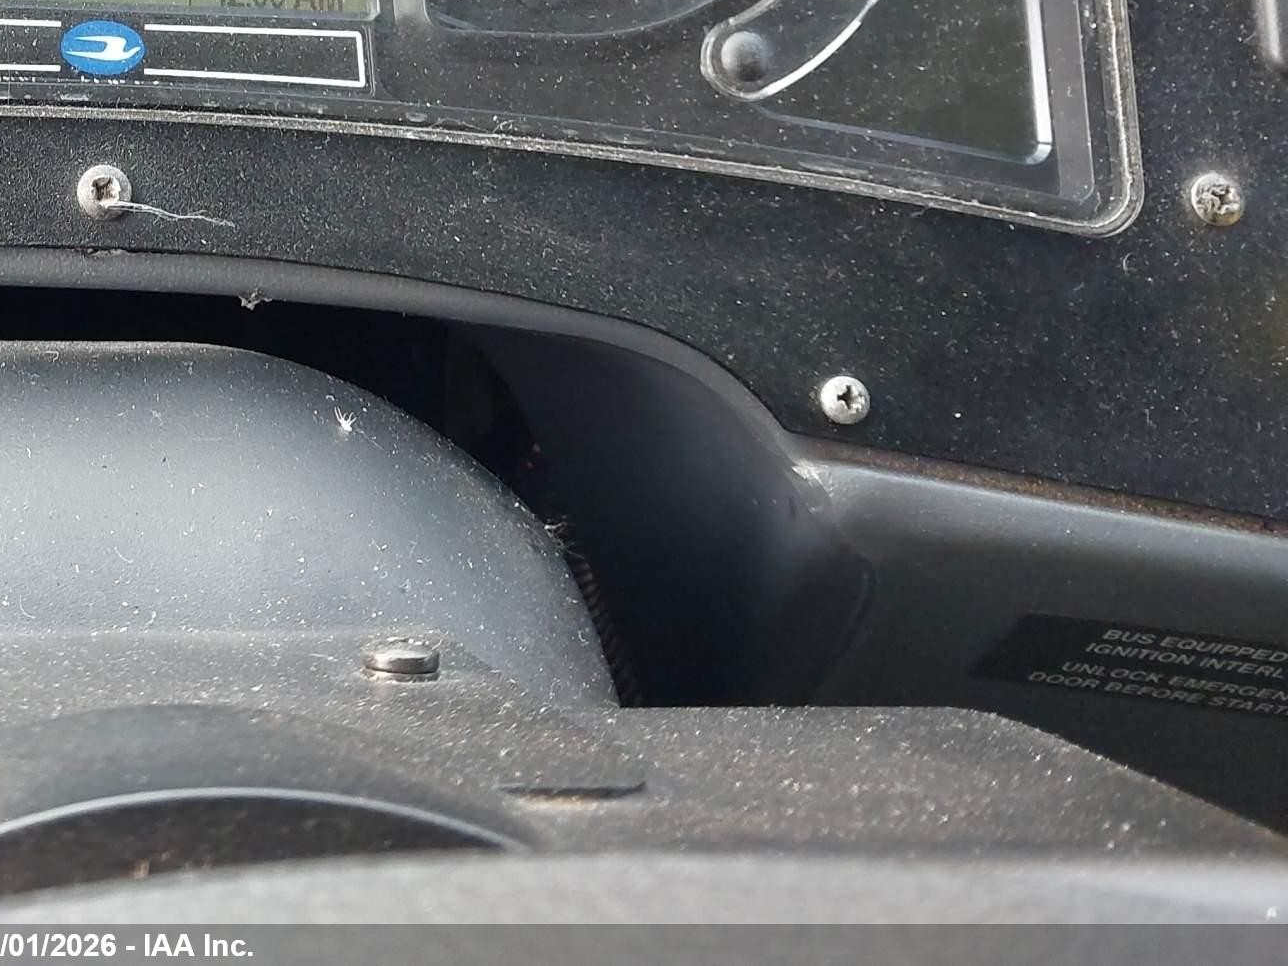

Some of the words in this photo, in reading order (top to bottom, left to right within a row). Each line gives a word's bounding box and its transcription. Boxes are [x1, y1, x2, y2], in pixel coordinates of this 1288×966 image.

[1085, 642, 1196, 666] IGNITION
[1103, 629, 1156, 645] BUS
[1160, 636, 1288, 662] EQUIPPED
[1062, 661, 1164, 684] UNLOCK
[1027, 671, 1100, 689] DOOR
[1104, 682, 1205, 705] BEFORE
[1209, 696, 1288, 715] START
